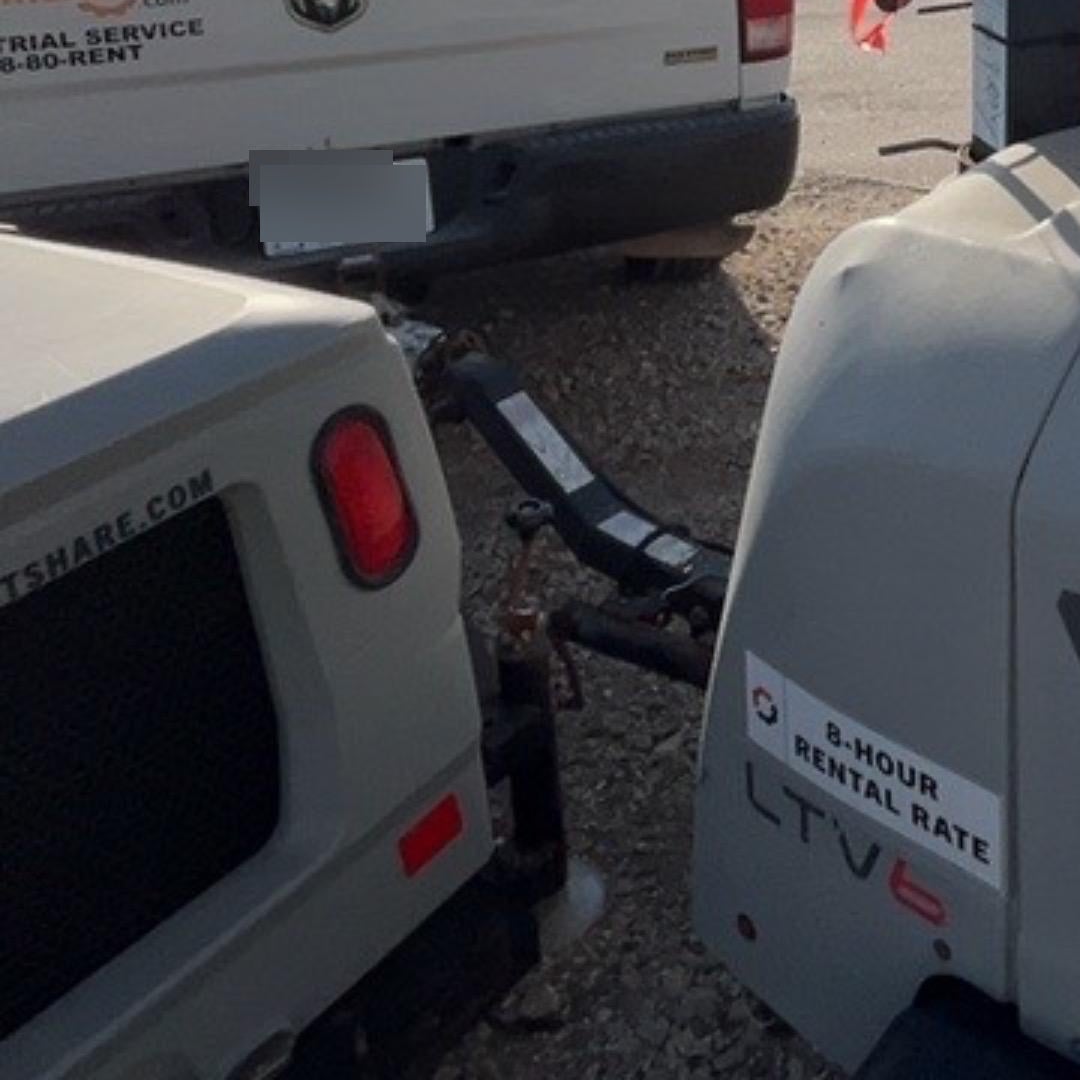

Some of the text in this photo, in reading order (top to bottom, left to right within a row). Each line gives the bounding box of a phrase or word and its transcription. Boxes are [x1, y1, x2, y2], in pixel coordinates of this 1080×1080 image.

[85, 18, 205, 45] SERVICE
[794, 735, 992, 865] RENTAL RATE
[826, 721, 940, 801] 8-HOUR
[745, 761, 948, 927] LTV6
